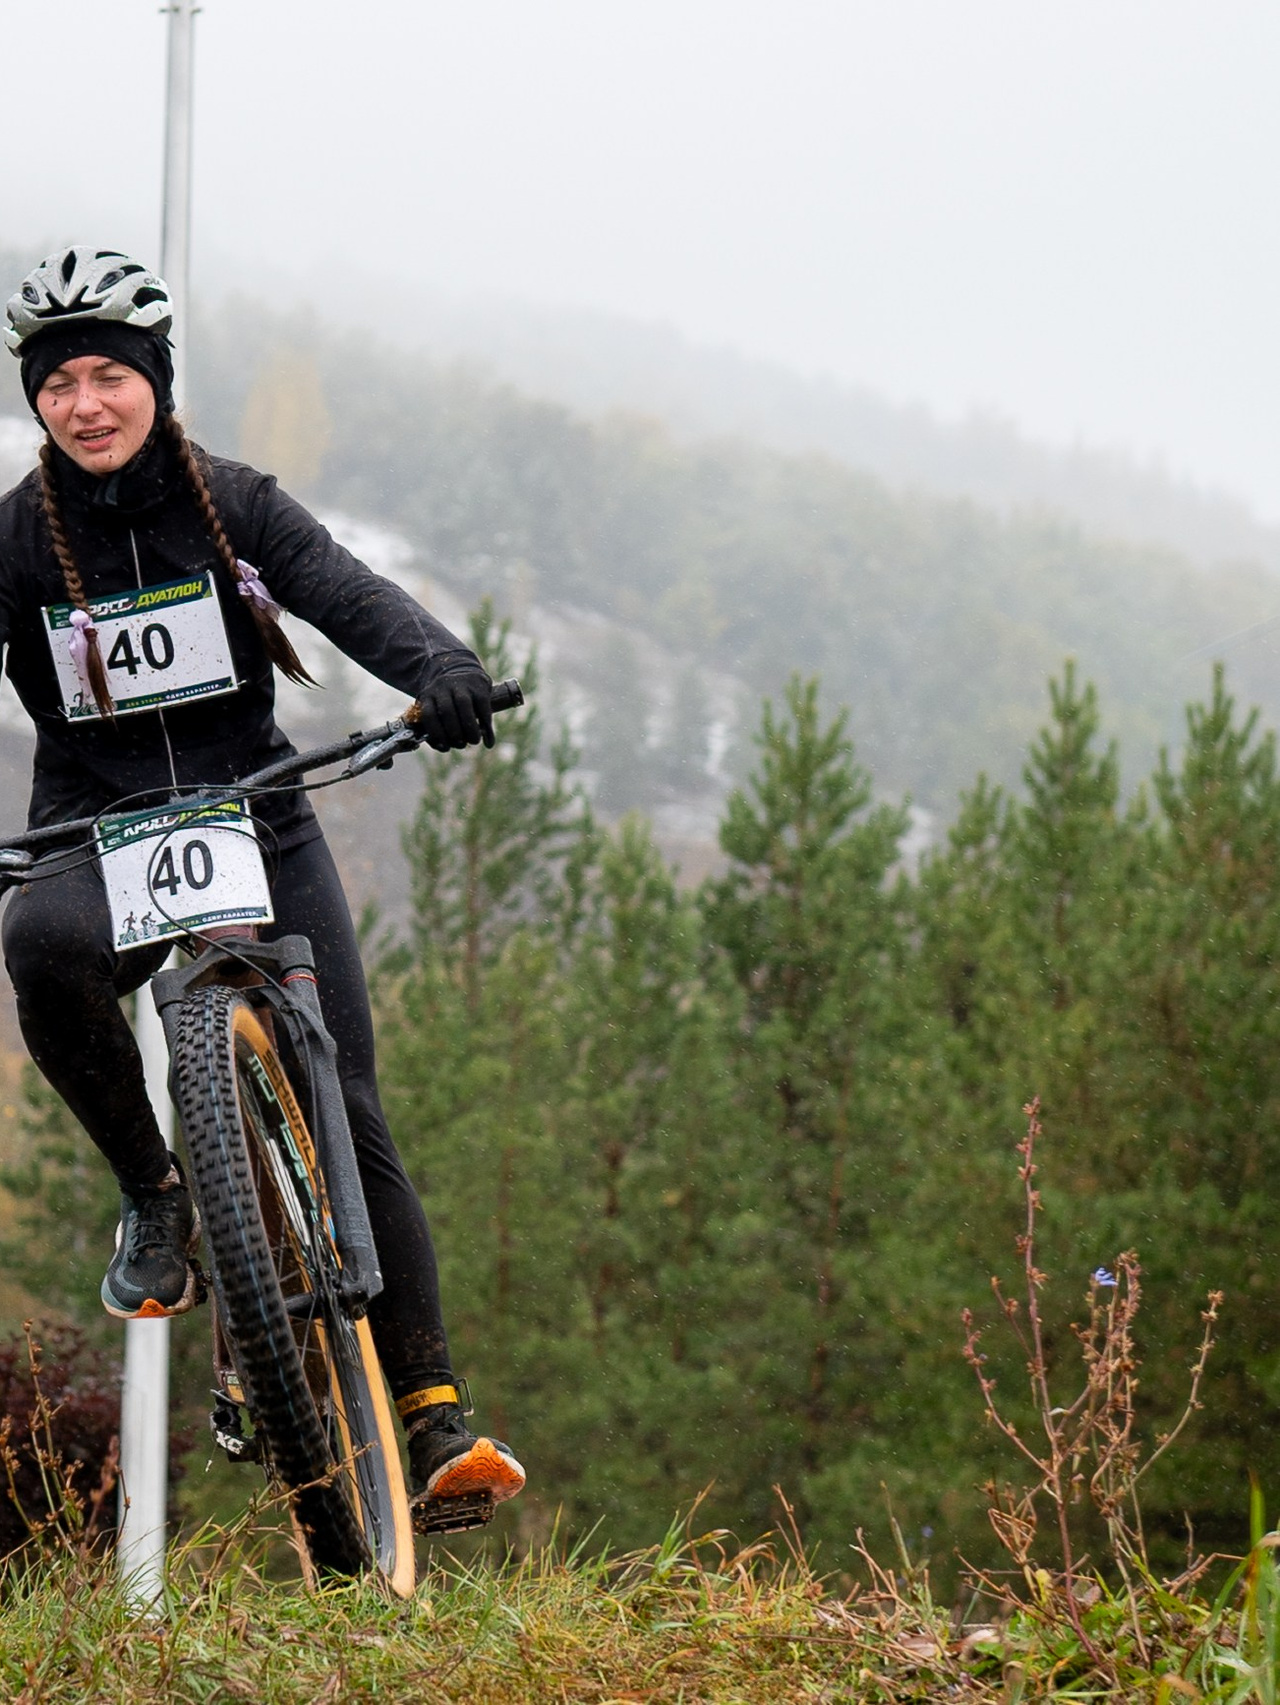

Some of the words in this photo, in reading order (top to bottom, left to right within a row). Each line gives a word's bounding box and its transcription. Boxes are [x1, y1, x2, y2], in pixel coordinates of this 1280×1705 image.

[136, 580, 203, 609] ДУАТЛОН
[106, 622, 176, 676] 40
[152, 839, 214, 896] 40
